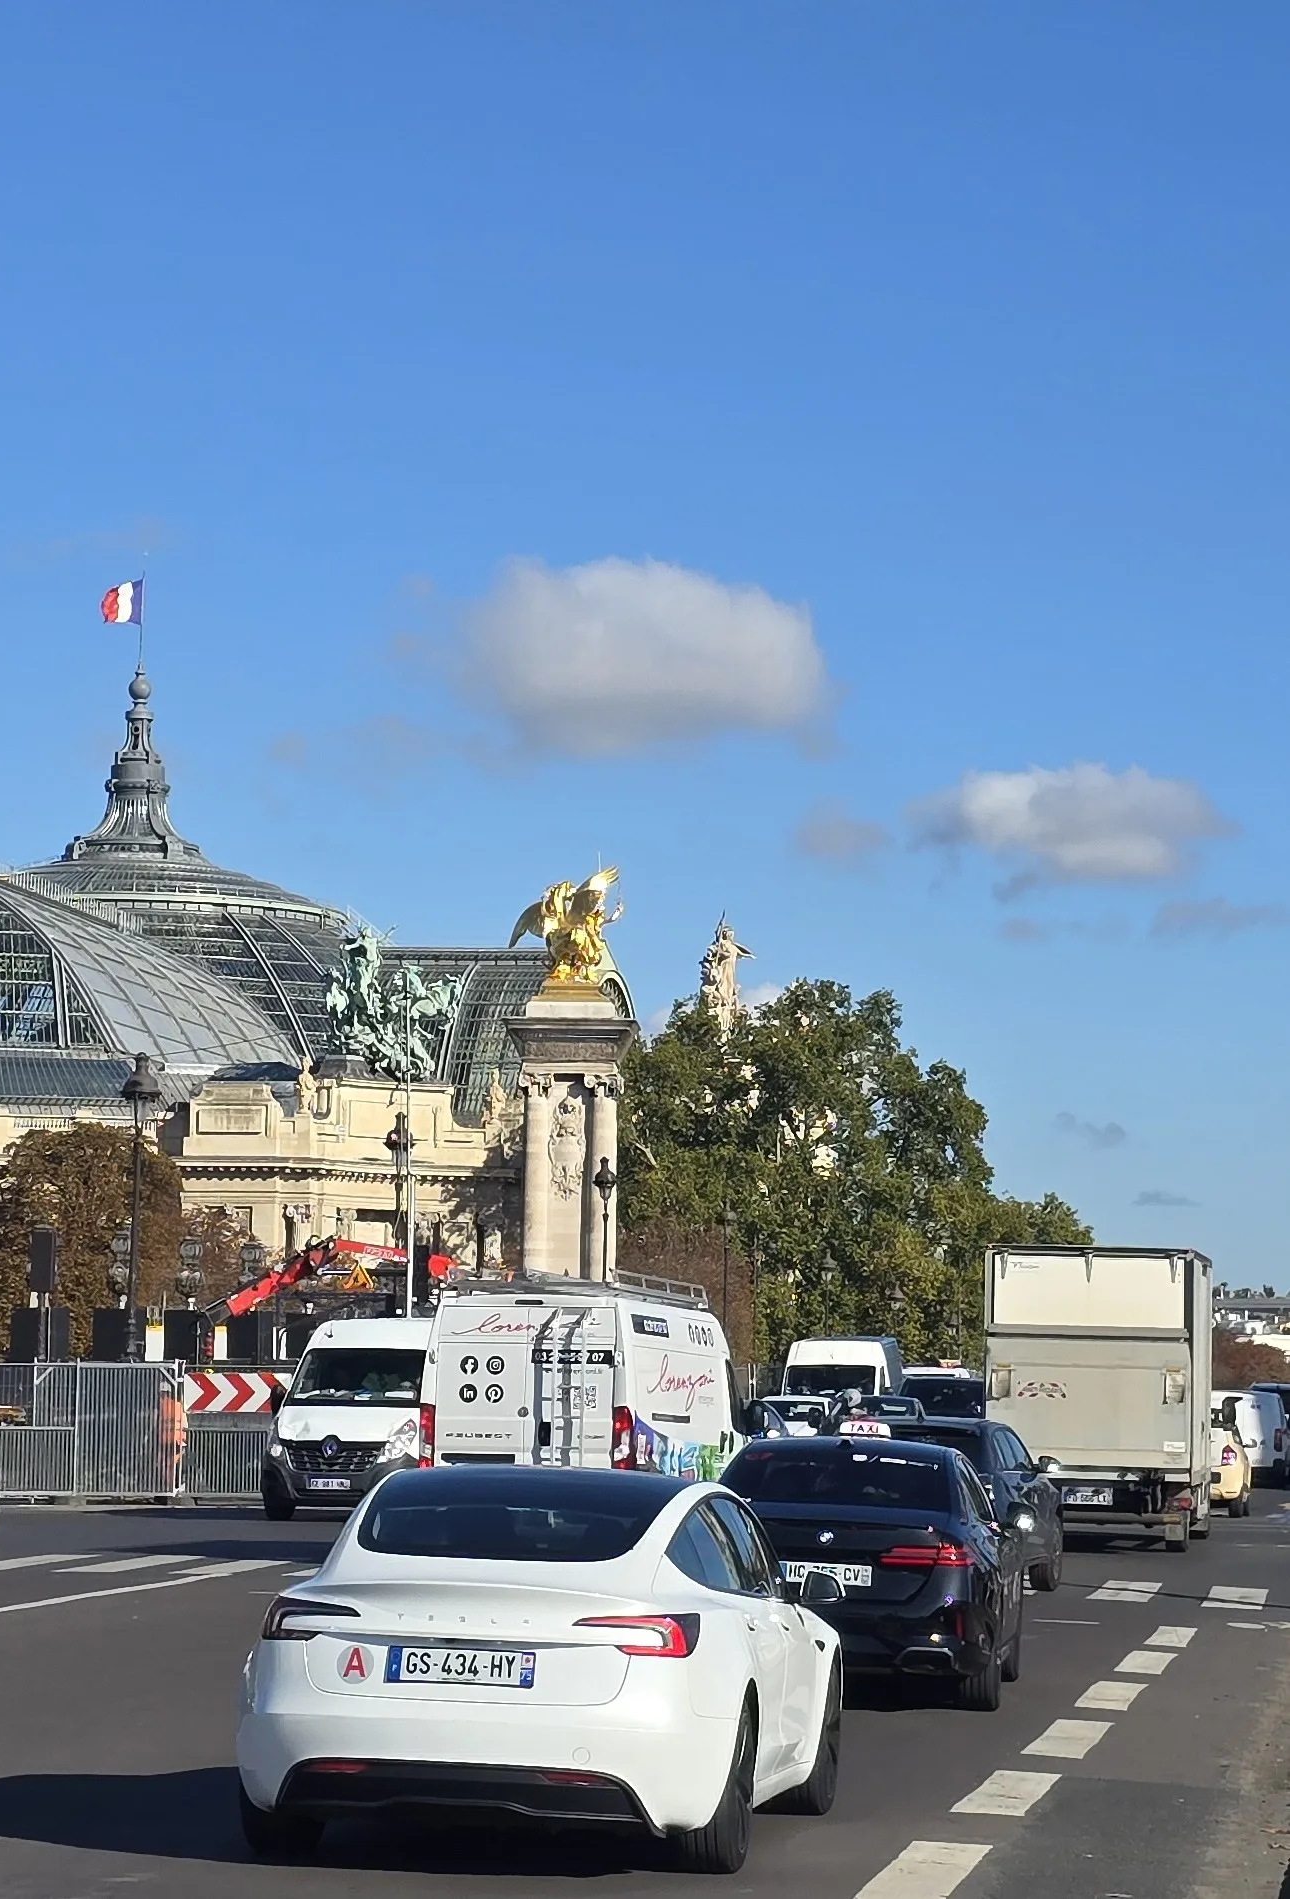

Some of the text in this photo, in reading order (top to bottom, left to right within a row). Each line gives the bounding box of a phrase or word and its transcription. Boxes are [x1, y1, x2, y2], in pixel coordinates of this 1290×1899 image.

[592, 1352, 605, 1362] 07
[850, 1423, 879, 1434] TAXI
[397, 1612, 531, 1625] TESLA
[342, 1646, 367, 1678] A
[405, 1651, 516, 1679] GS-434-HY
[520, 1670, 532, 1681] 75
